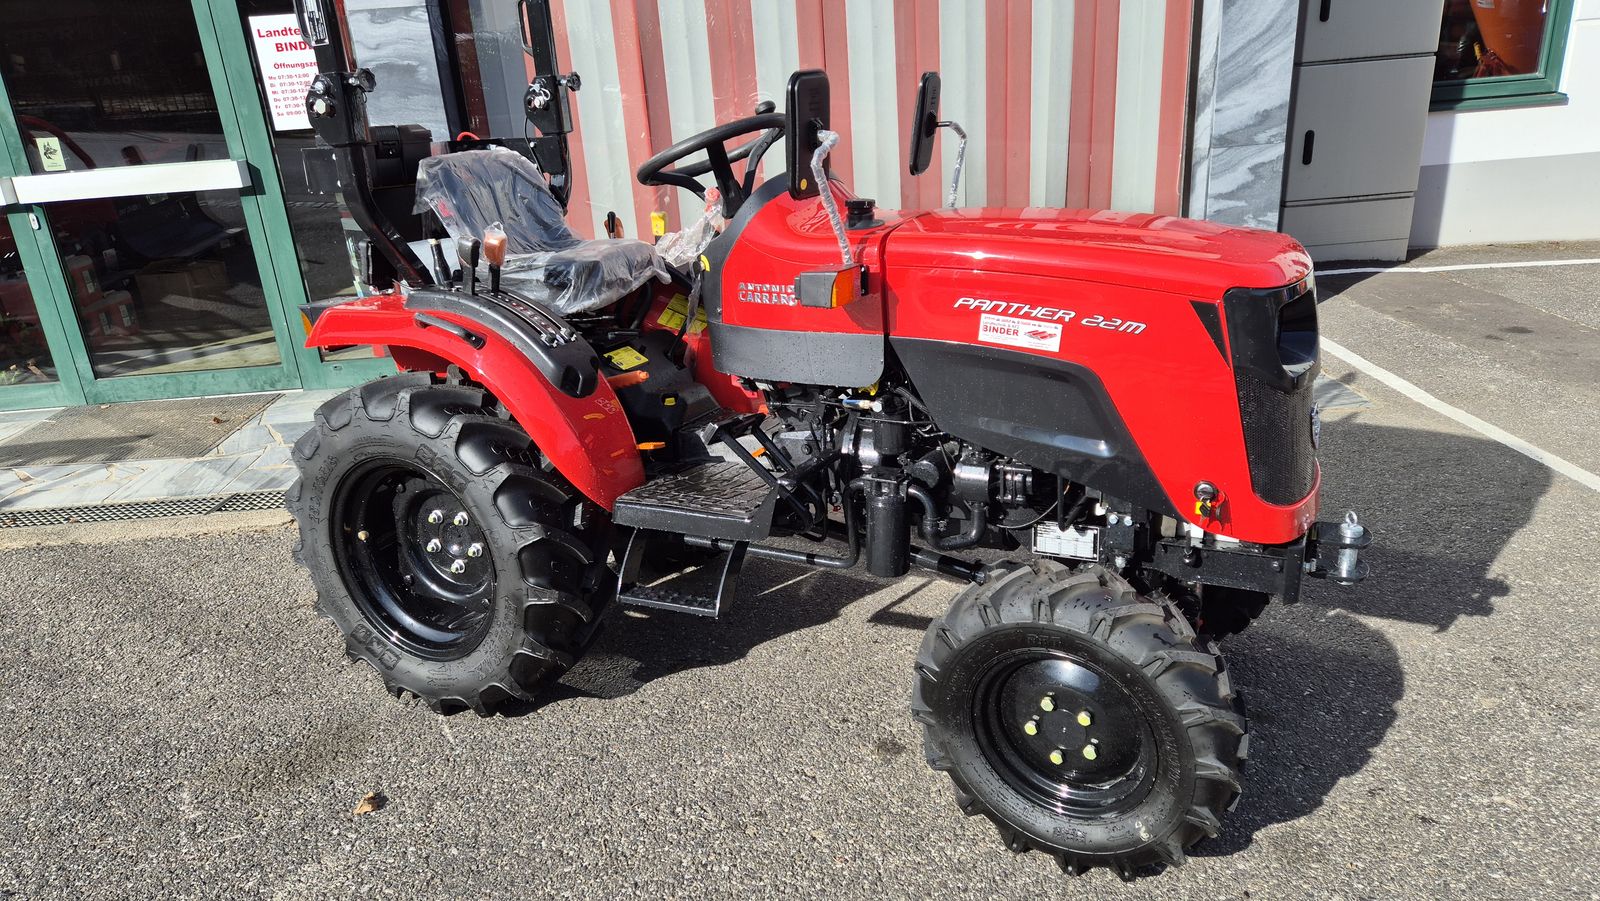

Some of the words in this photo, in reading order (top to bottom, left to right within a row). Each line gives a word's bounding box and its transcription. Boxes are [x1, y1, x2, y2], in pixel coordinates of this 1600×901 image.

[738, 282, 795, 293] ANTONIO
[738, 291, 798, 306] CARRARO
[953, 297, 1076, 322] PANTHER
[982, 324, 1019, 336] BINDER
